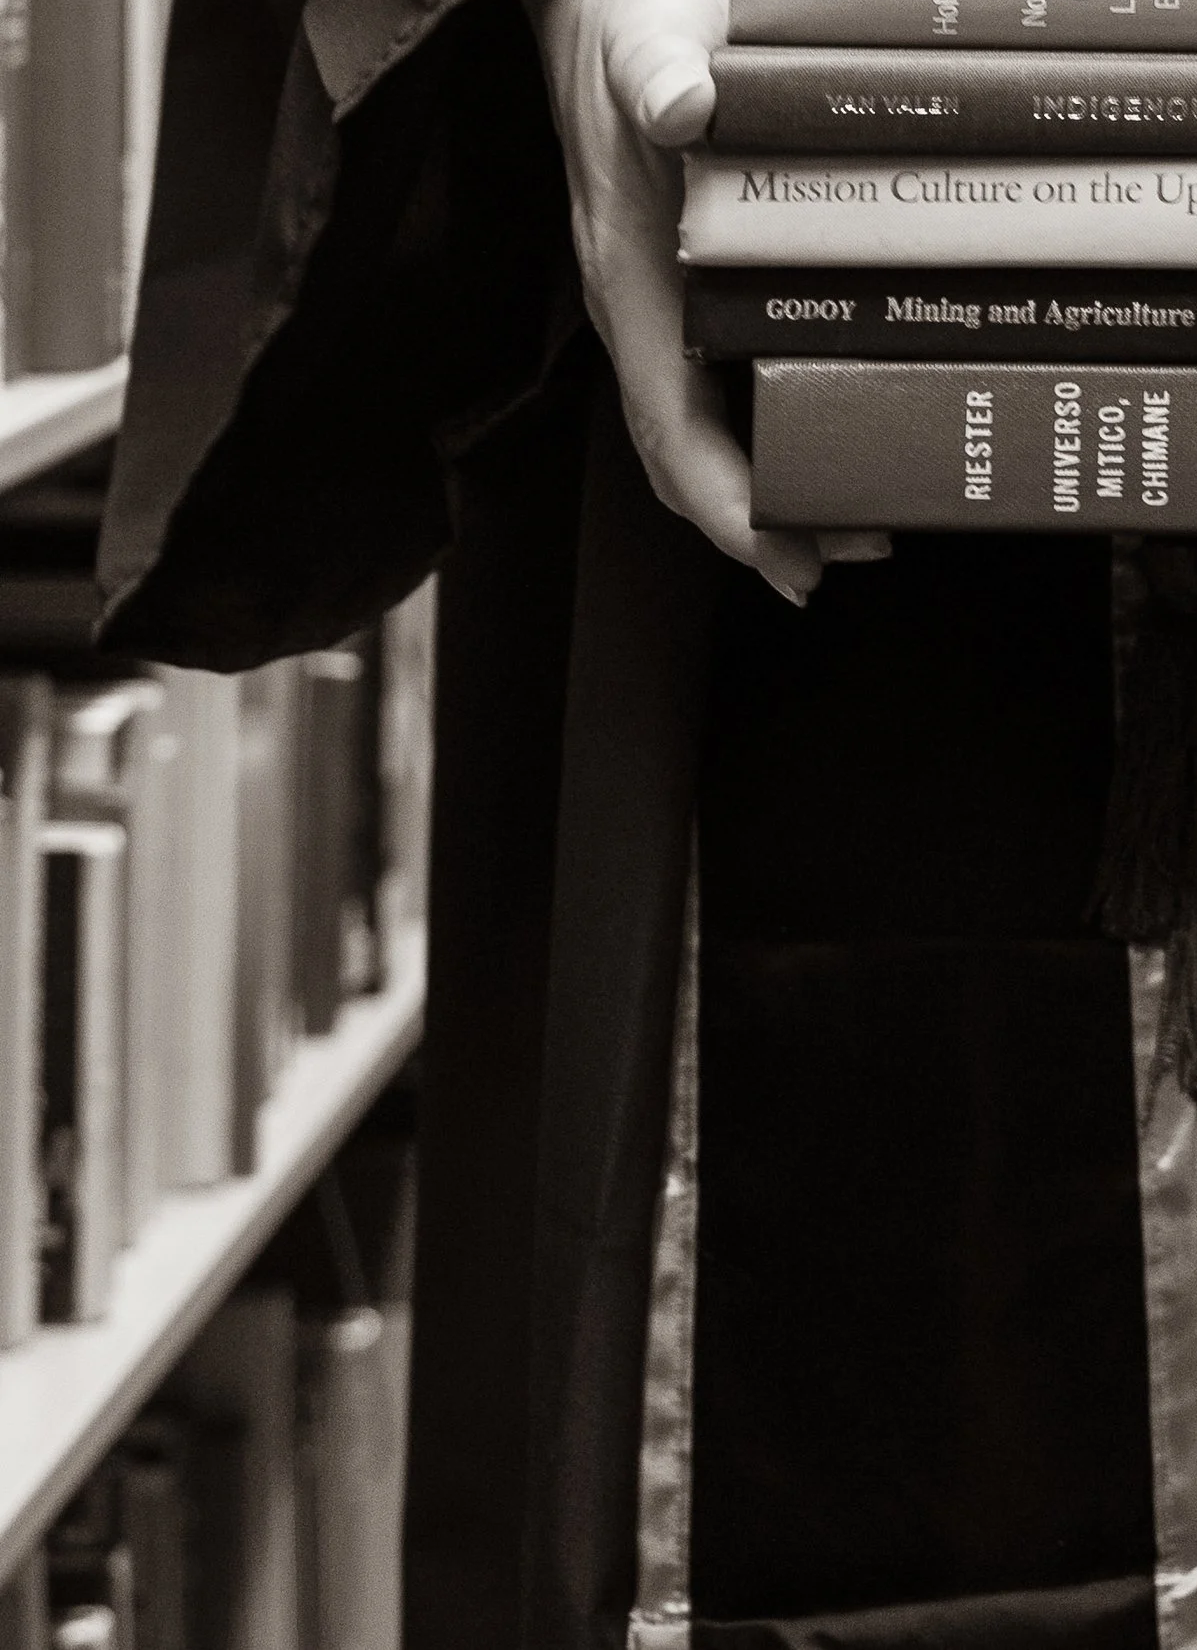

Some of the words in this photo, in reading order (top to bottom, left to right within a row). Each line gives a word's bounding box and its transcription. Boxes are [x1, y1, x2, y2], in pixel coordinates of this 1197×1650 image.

[825, 93, 876, 115] VAN
[880, 94, 959, 115] VALEN
[738, 169, 878, 203] Mission
[889, 171, 1023, 204] Culture
[1032, 182, 1078, 204] on
[1089, 172, 1142, 204] the
[766, 298, 857, 322] GODOY
[884, 296, 982, 330] Mining
[987, 299, 1037, 325] and
[1045, 299, 1196, 331] Agriculture
[964, 390, 994, 500] RIESTER
[1053, 381, 1082, 513] UNIVERSO
[1096, 397, 1131, 498] MITICO,
[1141, 390, 1171, 507] CHIMANE
